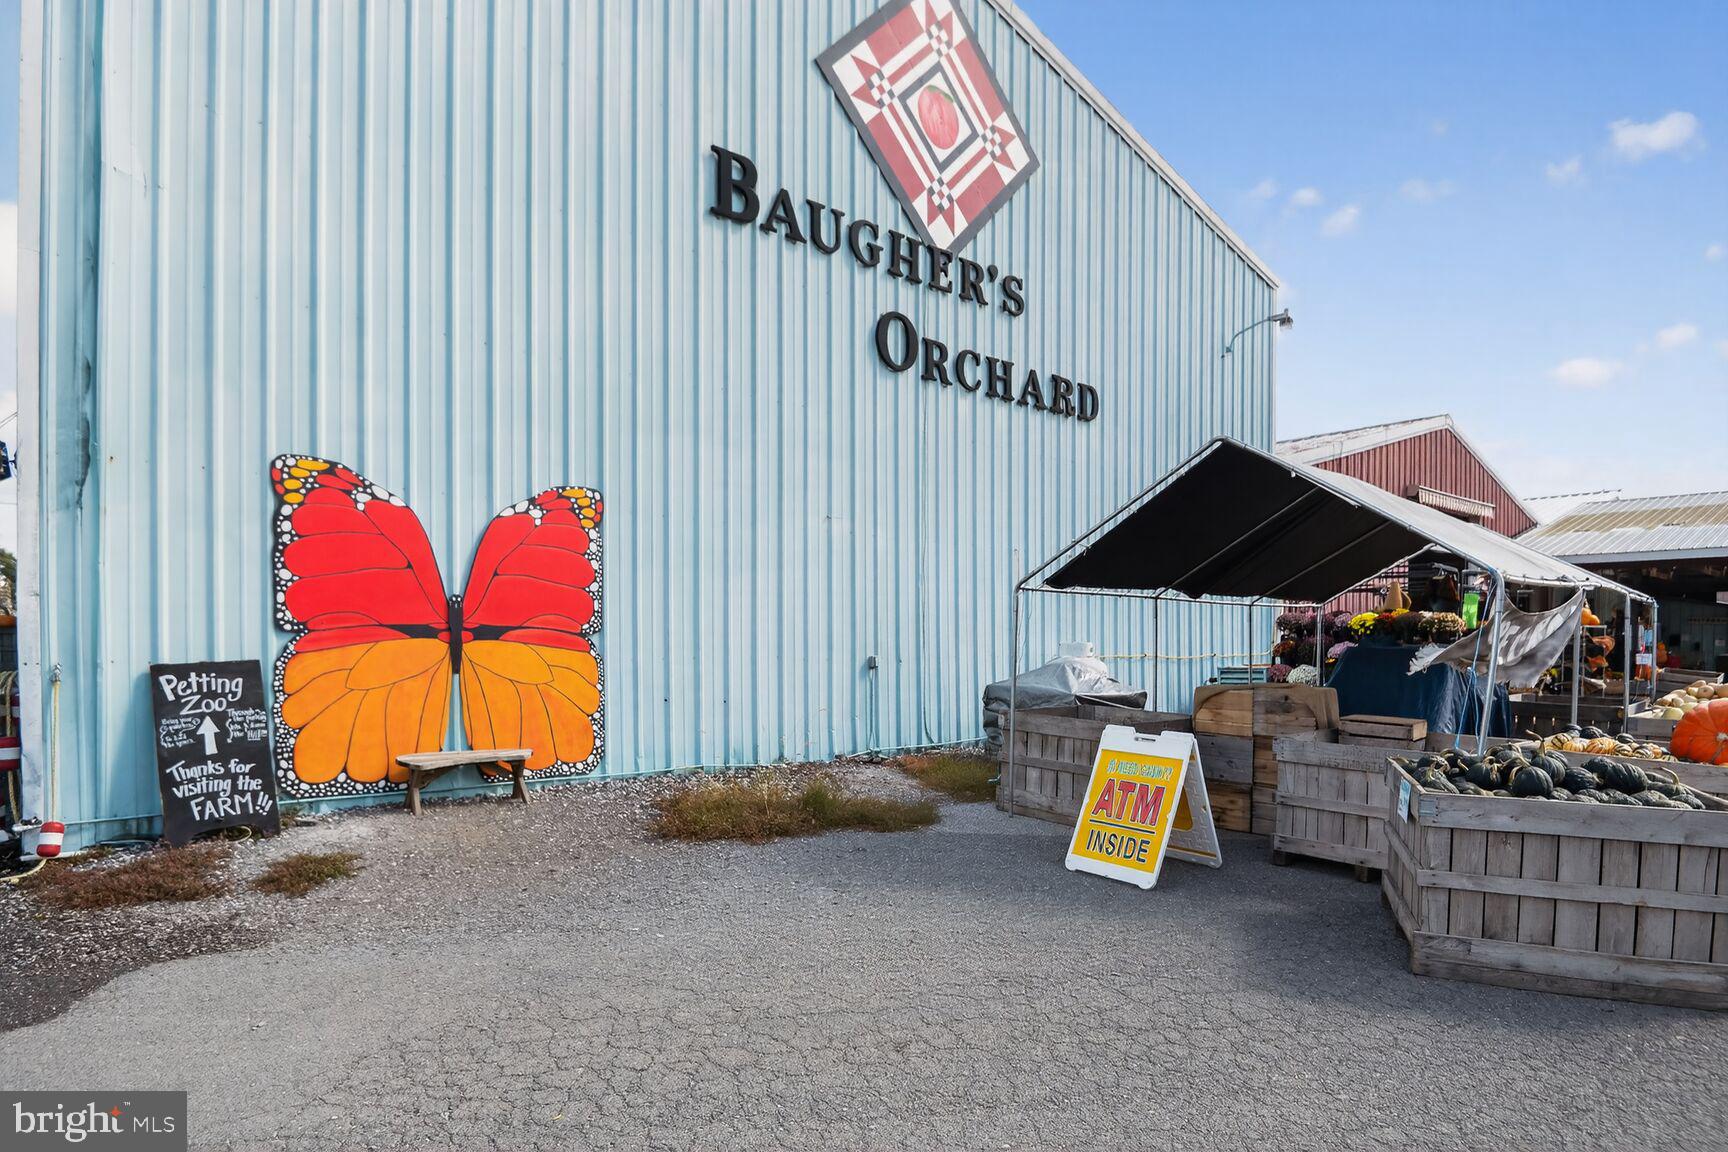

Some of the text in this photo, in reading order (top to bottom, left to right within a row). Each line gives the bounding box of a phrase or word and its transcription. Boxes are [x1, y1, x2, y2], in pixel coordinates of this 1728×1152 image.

[710, 144, 1026, 317] BAUGHER'S
[875, 311, 1100, 423] ORCHARD
[159, 672, 243, 702] Petting
[179, 695, 227, 715] Zoo
[166, 758, 256, 782] Thanks for
[172, 775, 262, 799] visiting the
[1091, 778, 1166, 827] ATM
[1086, 829, 1151, 863] INSIDE
